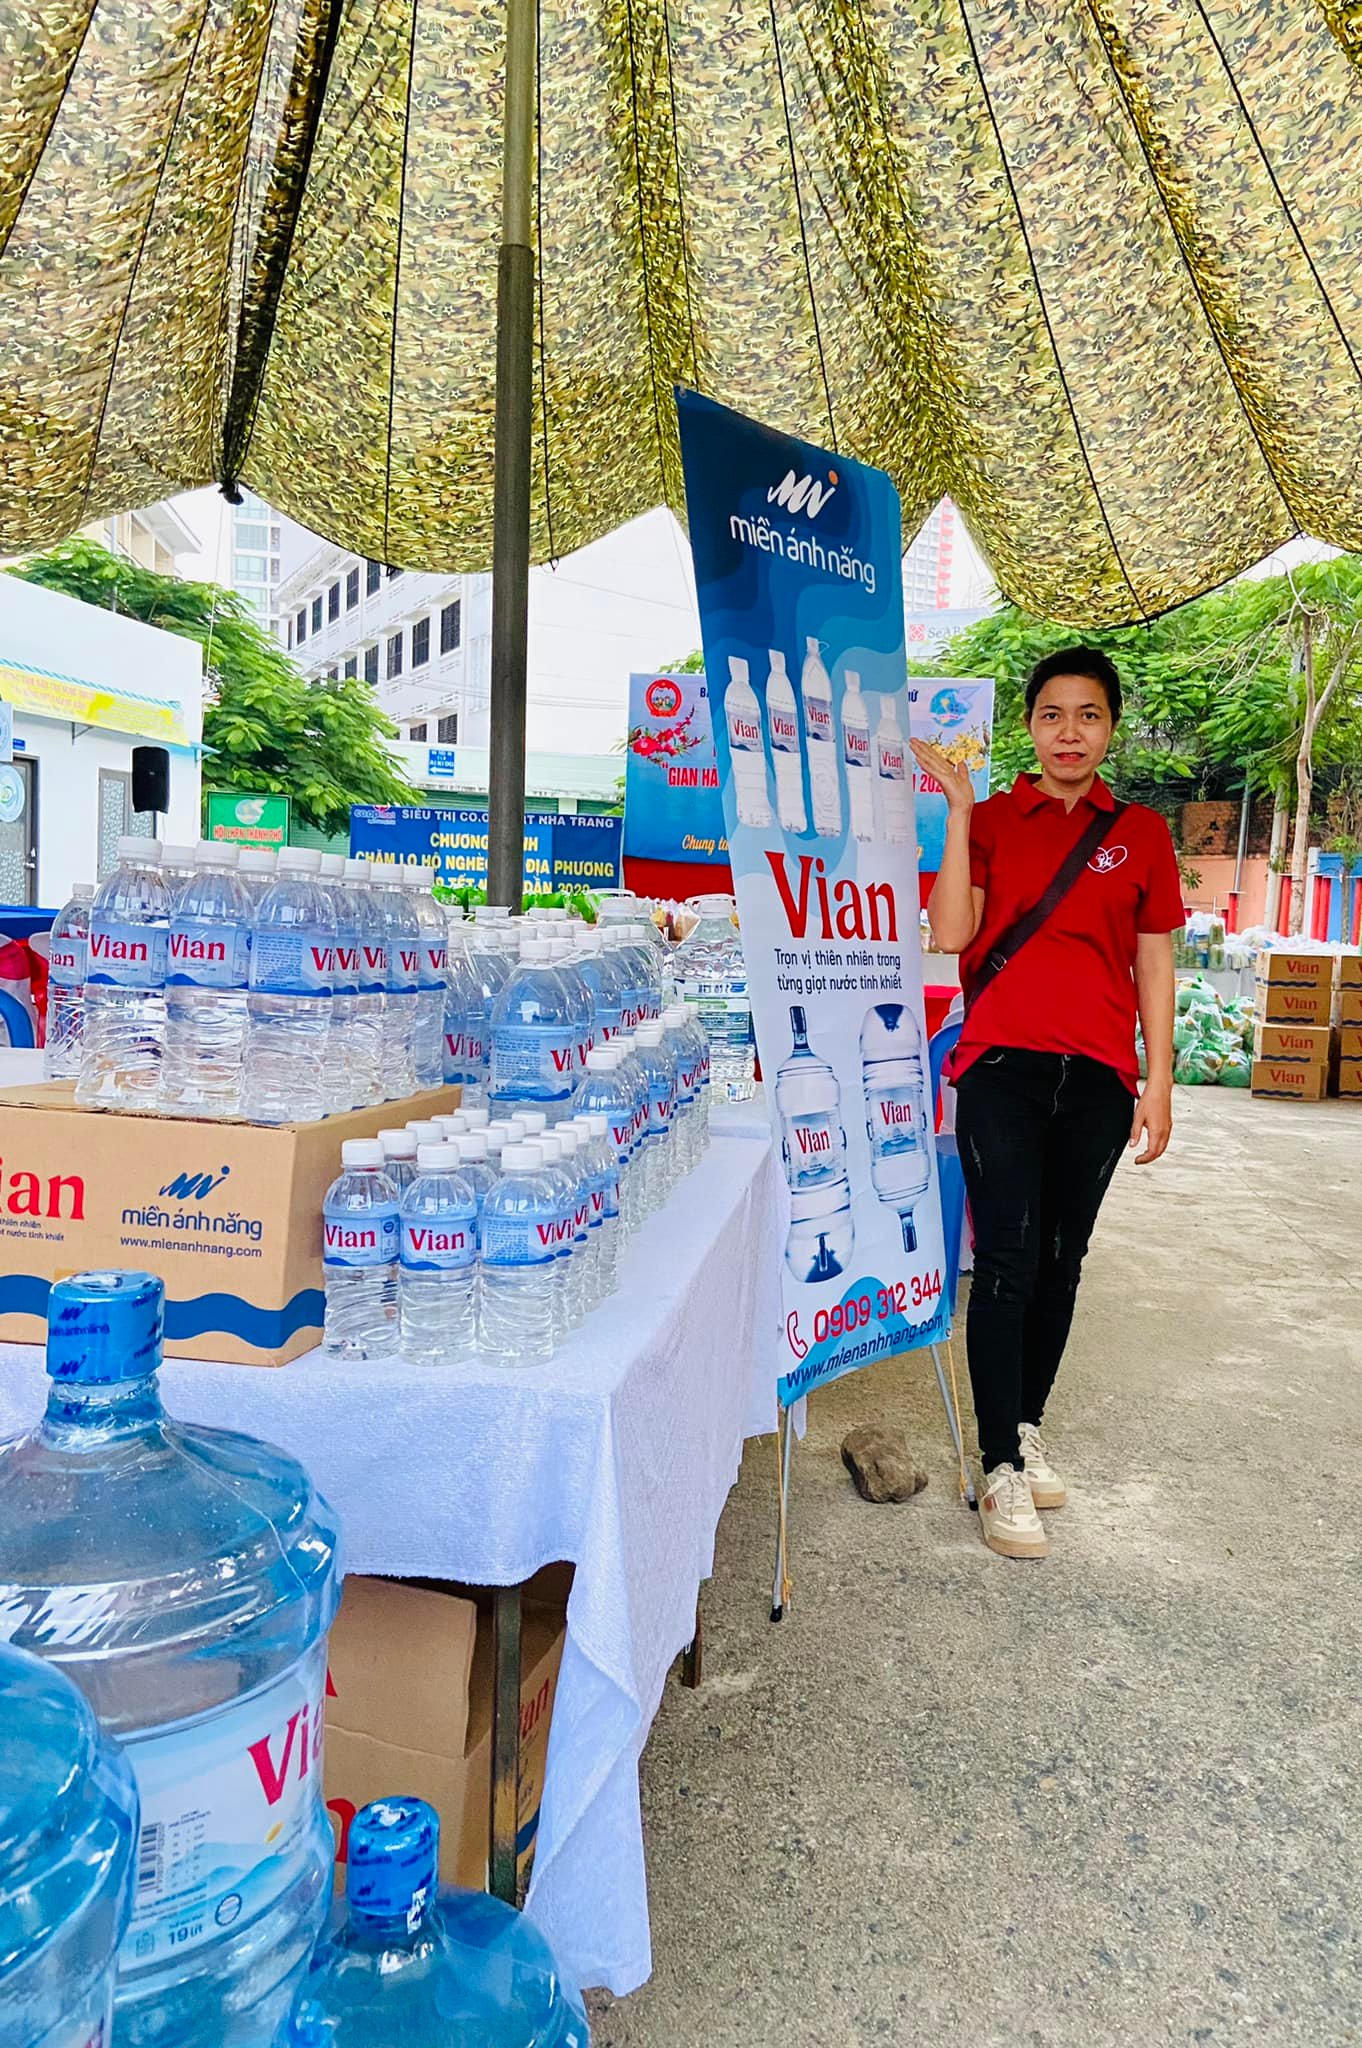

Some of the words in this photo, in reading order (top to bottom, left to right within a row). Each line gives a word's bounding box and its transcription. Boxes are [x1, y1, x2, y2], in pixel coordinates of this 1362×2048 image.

[729, 515, 784, 556] miền
[787, 527, 826, 570] ánh
[828, 545, 876, 594] nắng
[734, 719, 759, 739] Vian
[773, 717, 796, 737] Vian
[847, 734, 869, 751] Vian
[919, 773, 945, 793] 202
[402, 808, 431, 820] SIÊU
[435, 810, 456, 823] THỊ
[538, 815, 566, 827] NHA
[569, 817, 614, 828] TRANG
[682, 834, 715, 856] Chung
[445, 853, 488, 871] NGHÈ
[525, 858, 550, 876] ĐỊA
[554, 860, 615, 877] PHƯƠNG
[764, 850, 898, 942] Vian
[90, 933, 148, 961] Vian
[170, 933, 225, 961] Vian
[310, 946, 335, 972] Vi
[336, 947, 360, 971] Vi
[400, 951, 418, 972] Vi
[428, 949, 448, 969] Vi
[774, 948, 798, 969] Trọn
[801, 950, 812, 969] vị
[815, 950, 843, 966] thiên
[846, 951, 874, 967] nhiên
[877, 954, 901, 970] trong
[1286, 959, 1319, 975] Vian
[778, 974, 803, 994] từng
[806, 976, 827, 994] giọt
[830, 974, 858, 990] nước
[880, 971, 902, 990] khiết
[1284, 996, 1317, 1011] Vian
[1278, 1034, 1314, 1049] Vian
[551, 1048, 573, 1073] Vi
[1270, 1069, 1305, 1085] Vian
[879, 1100, 912, 1125] Vian
[795, 1128, 830, 1154] Vian
[121, 1205, 170, 1228] miền
[173, 1208, 210, 1231] ánh
[213, 1212, 263, 1241] nắng
[120, 1236, 262, 1258] www.mienanhnang.com
[324, 1223, 376, 1248] Vian
[409, 1228, 464, 1251] Vian
[814, 1296, 871, 1343] 0909
[877, 1282, 908, 1319] 312
[911, 1268, 942, 1306] 344
[786, 1313, 943, 1388] www.mienanhnang.com
[169, 1928, 188, 1945] 19
